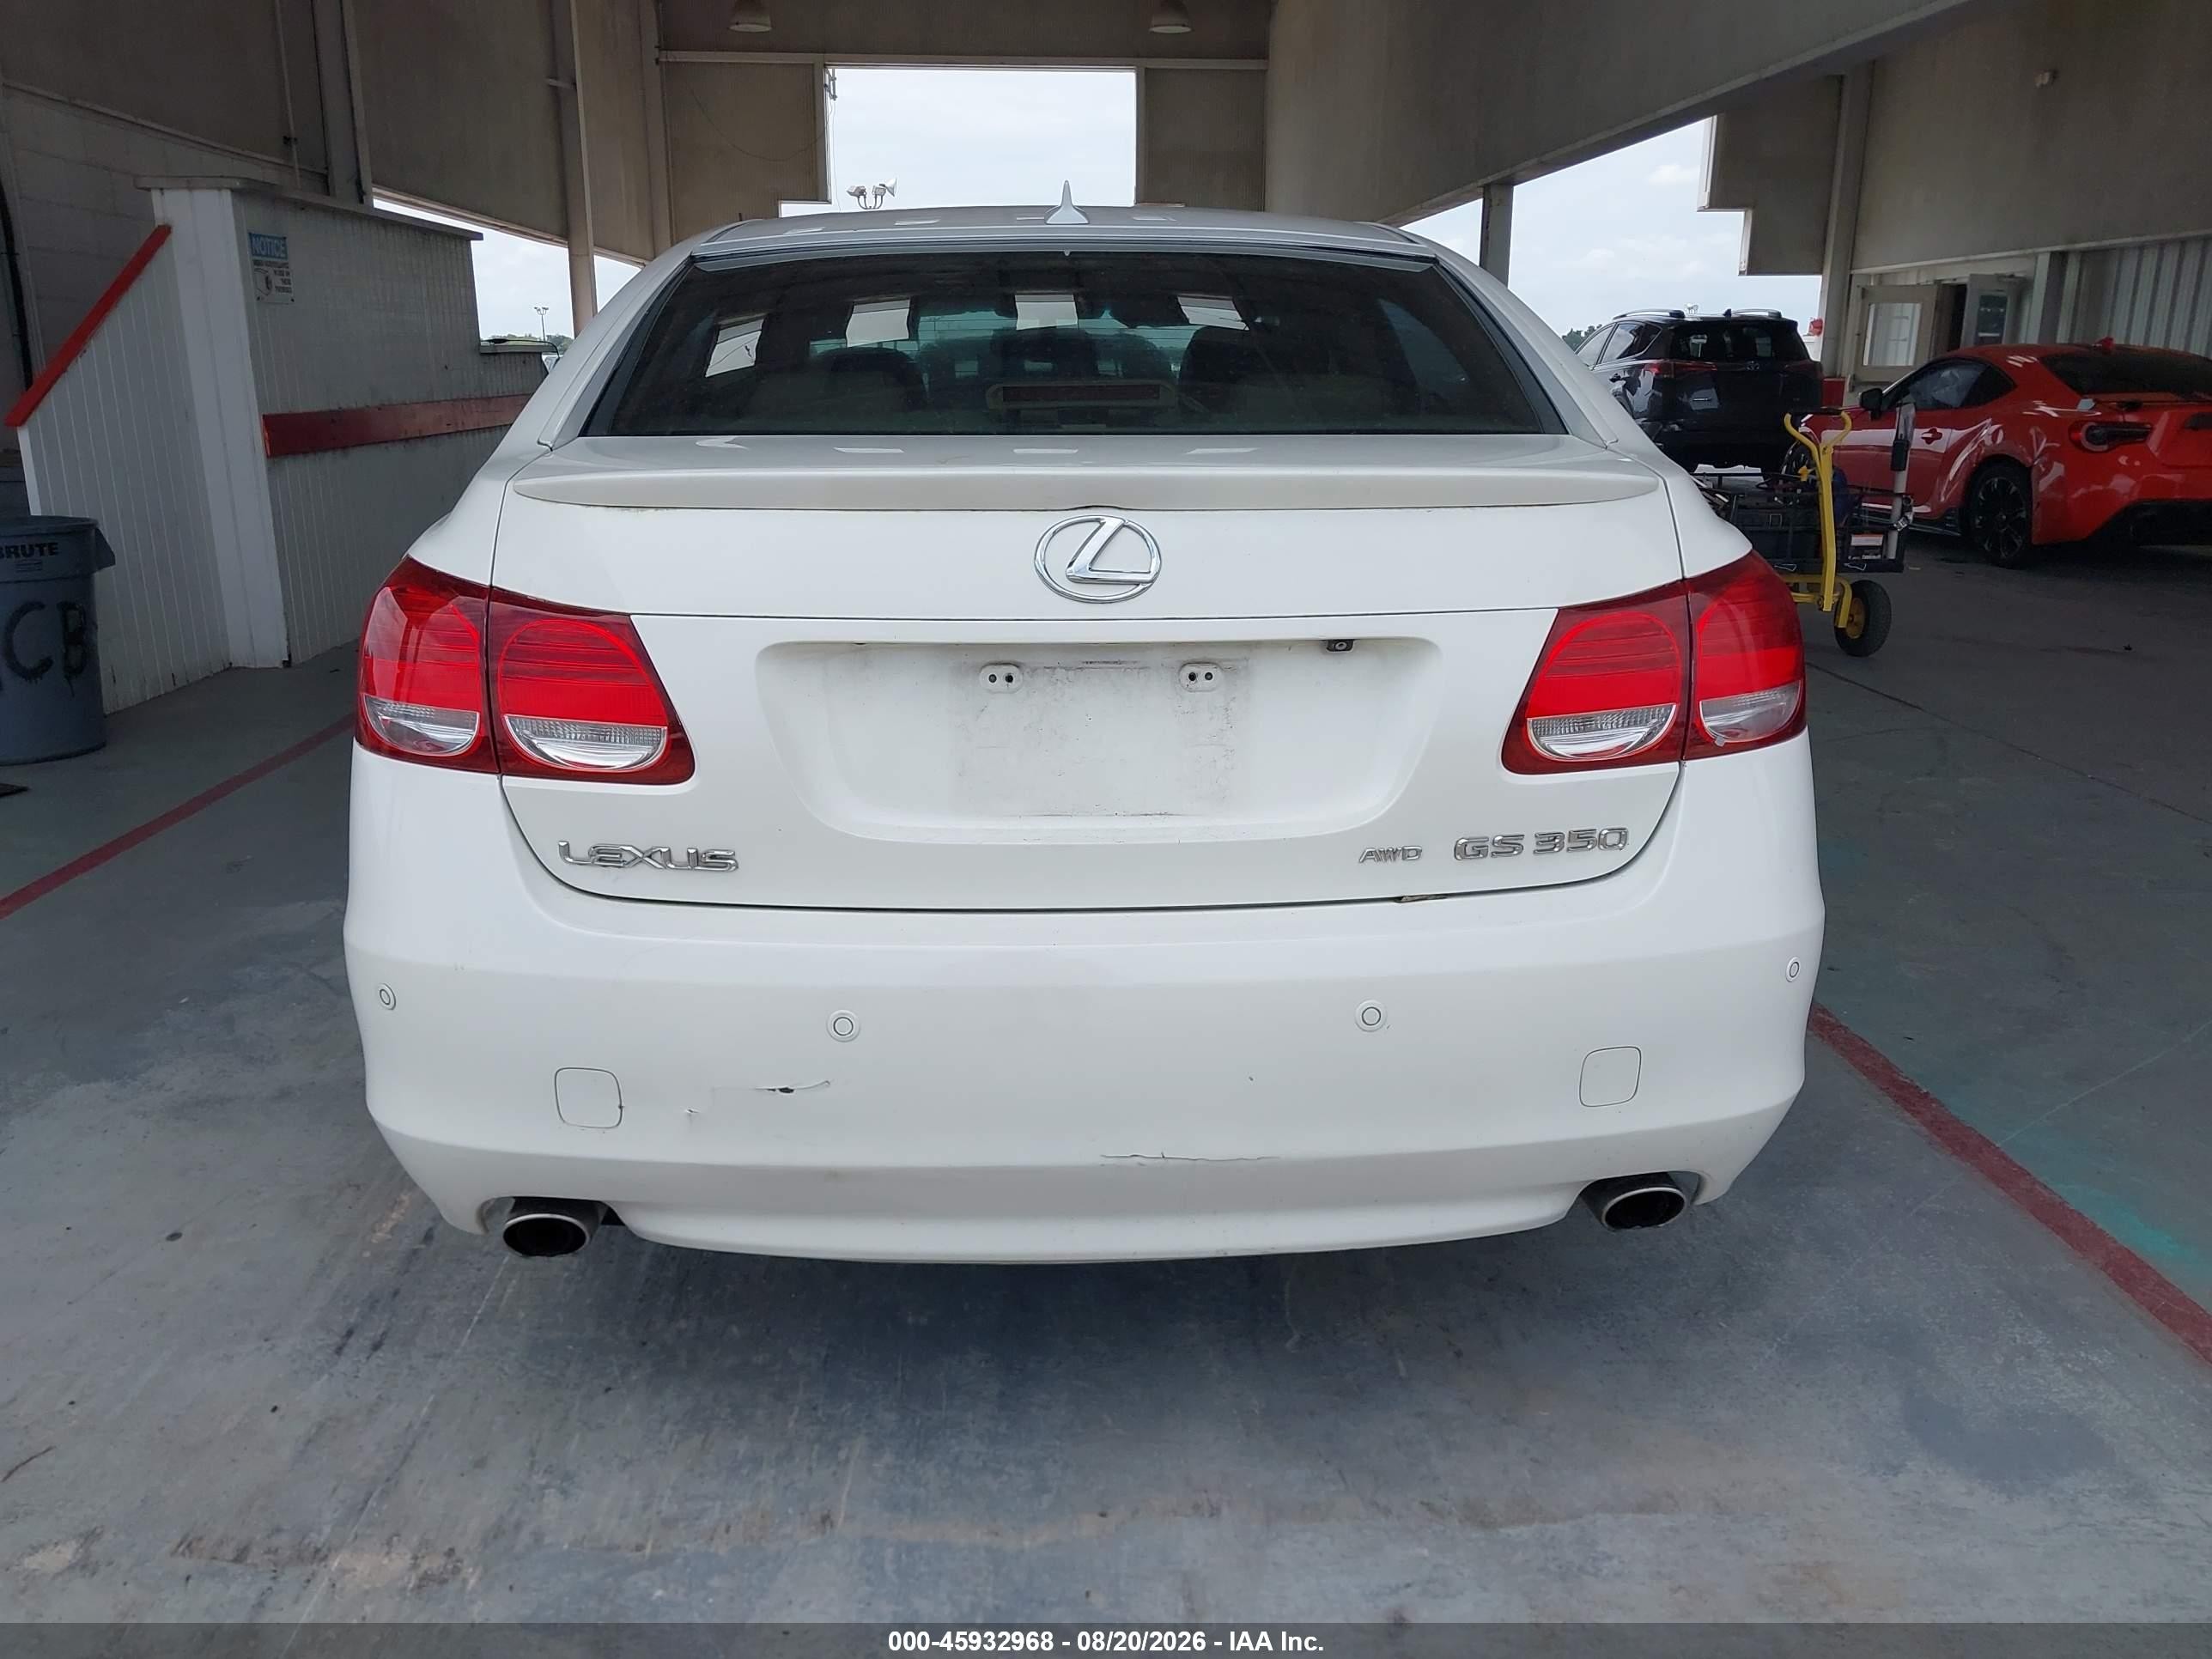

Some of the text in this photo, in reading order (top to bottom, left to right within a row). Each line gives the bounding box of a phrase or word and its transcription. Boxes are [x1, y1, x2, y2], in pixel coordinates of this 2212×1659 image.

[252, 237, 287, 258] NOTICE
[558, 840, 738, 872] LEXUS
[1359, 845, 1423, 864] AWD
[1454, 827, 1629, 860] GS 350
